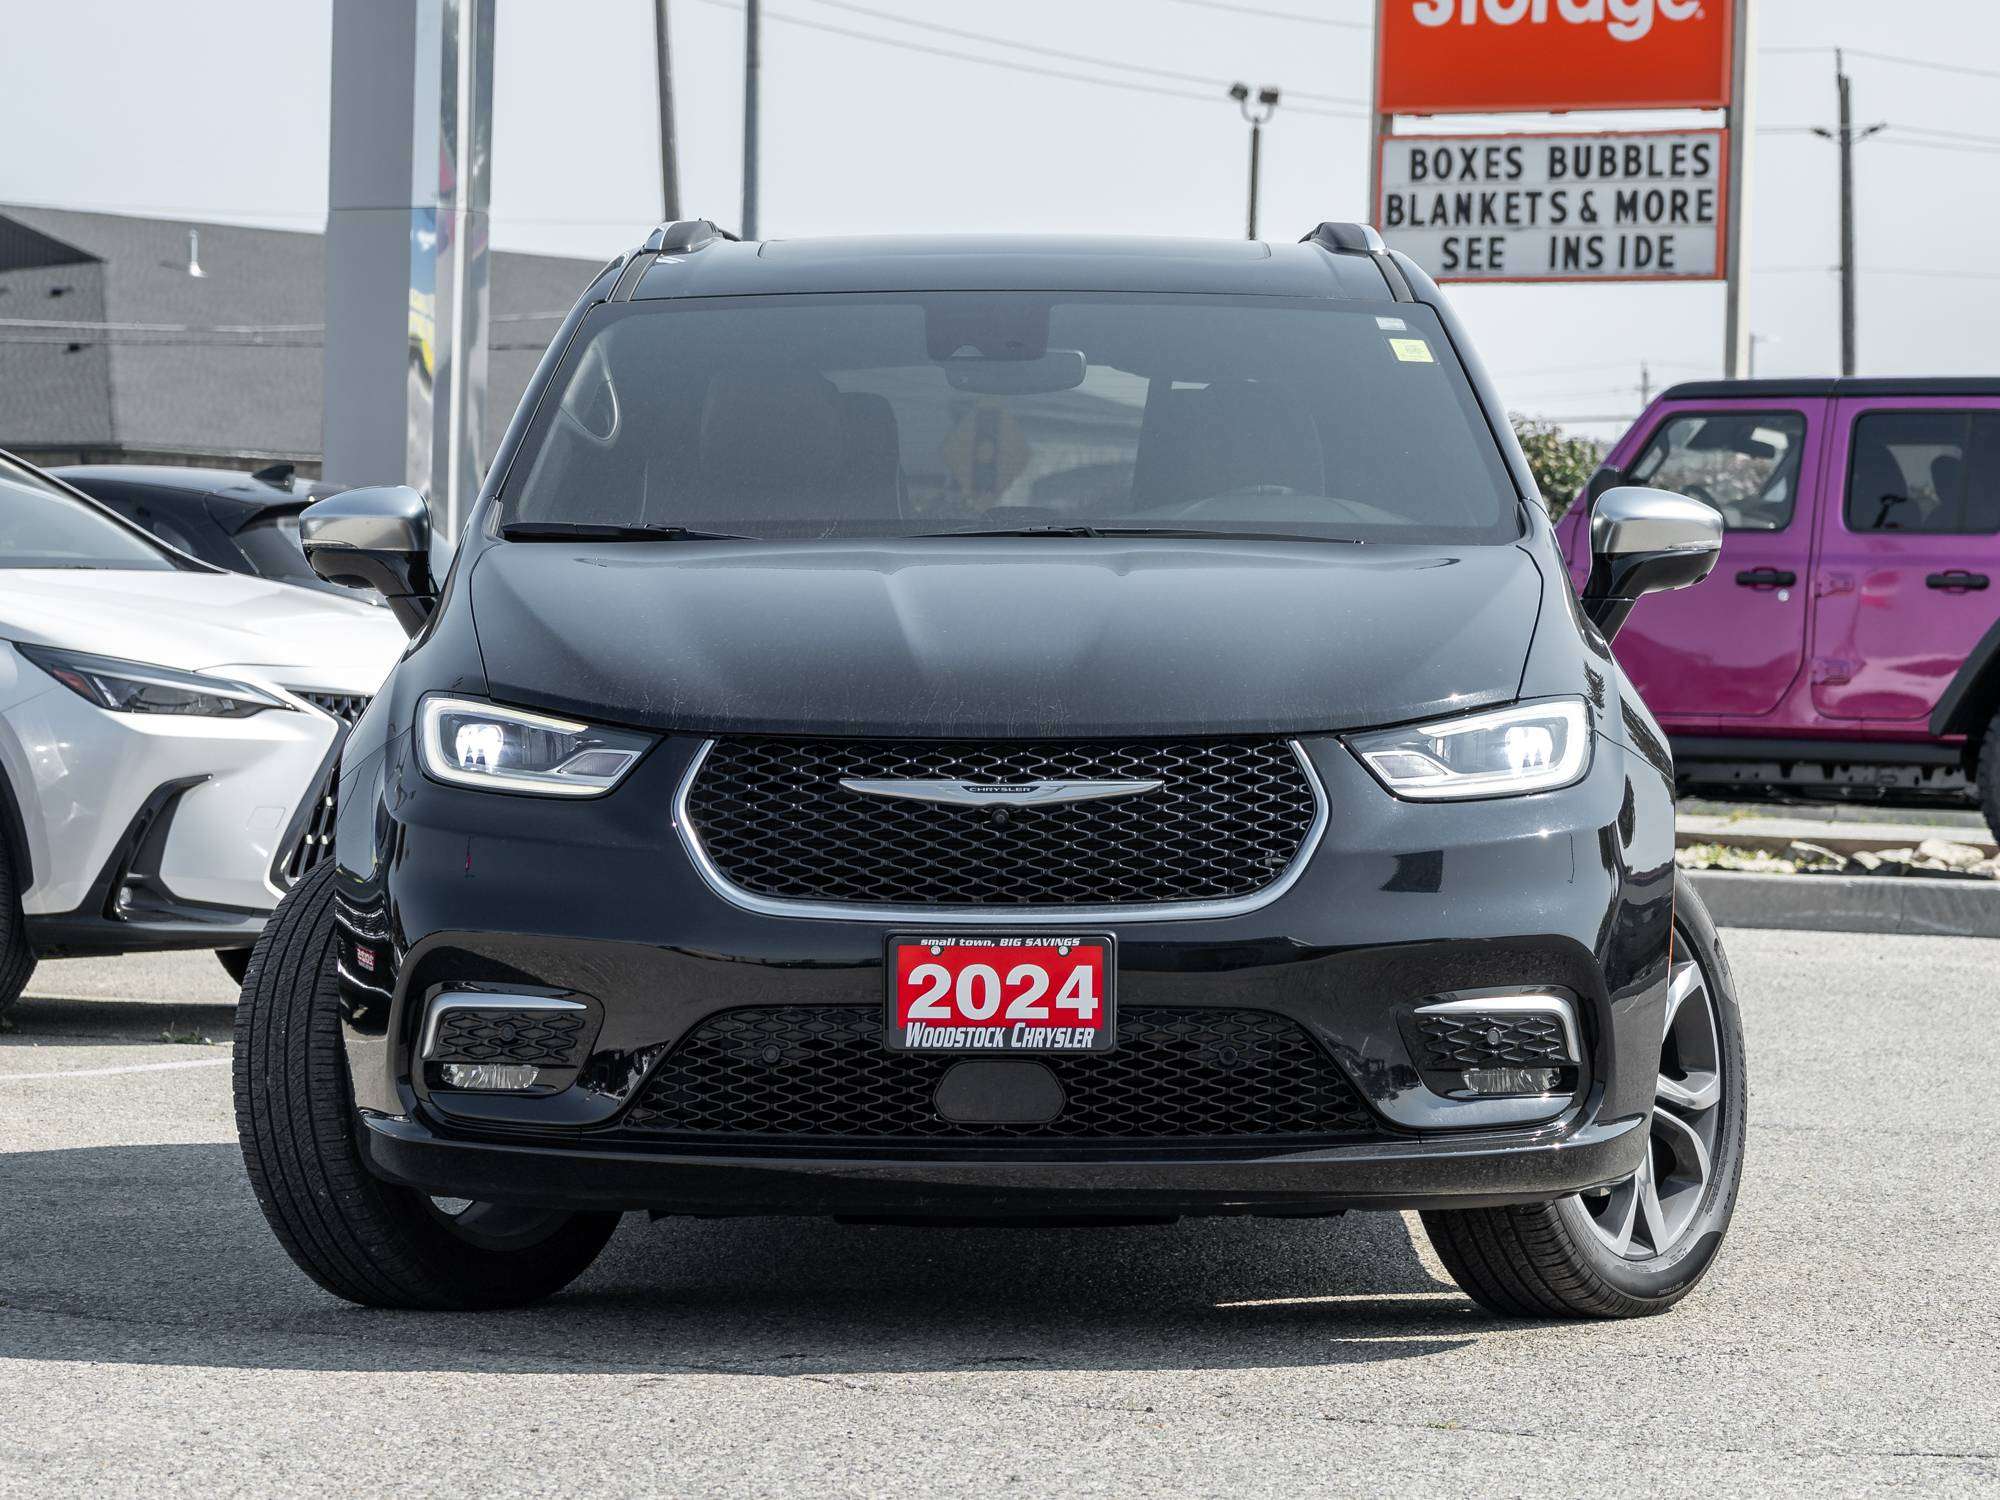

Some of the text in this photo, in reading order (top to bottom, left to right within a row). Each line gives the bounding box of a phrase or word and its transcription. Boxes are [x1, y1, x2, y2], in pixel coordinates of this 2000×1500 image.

[1410, 143, 1710, 182] BOXES BUBBLES
[1386, 188, 1714, 226] BLANKETS & MORE
[1442, 235, 1675, 271] SEE INSIDE
[920, 937, 1080, 947] small town, BIG SAVINGS
[907, 963, 1099, 1020] 2024
[905, 1022, 1095, 1048] WOODSTOCK CHRYSLER
